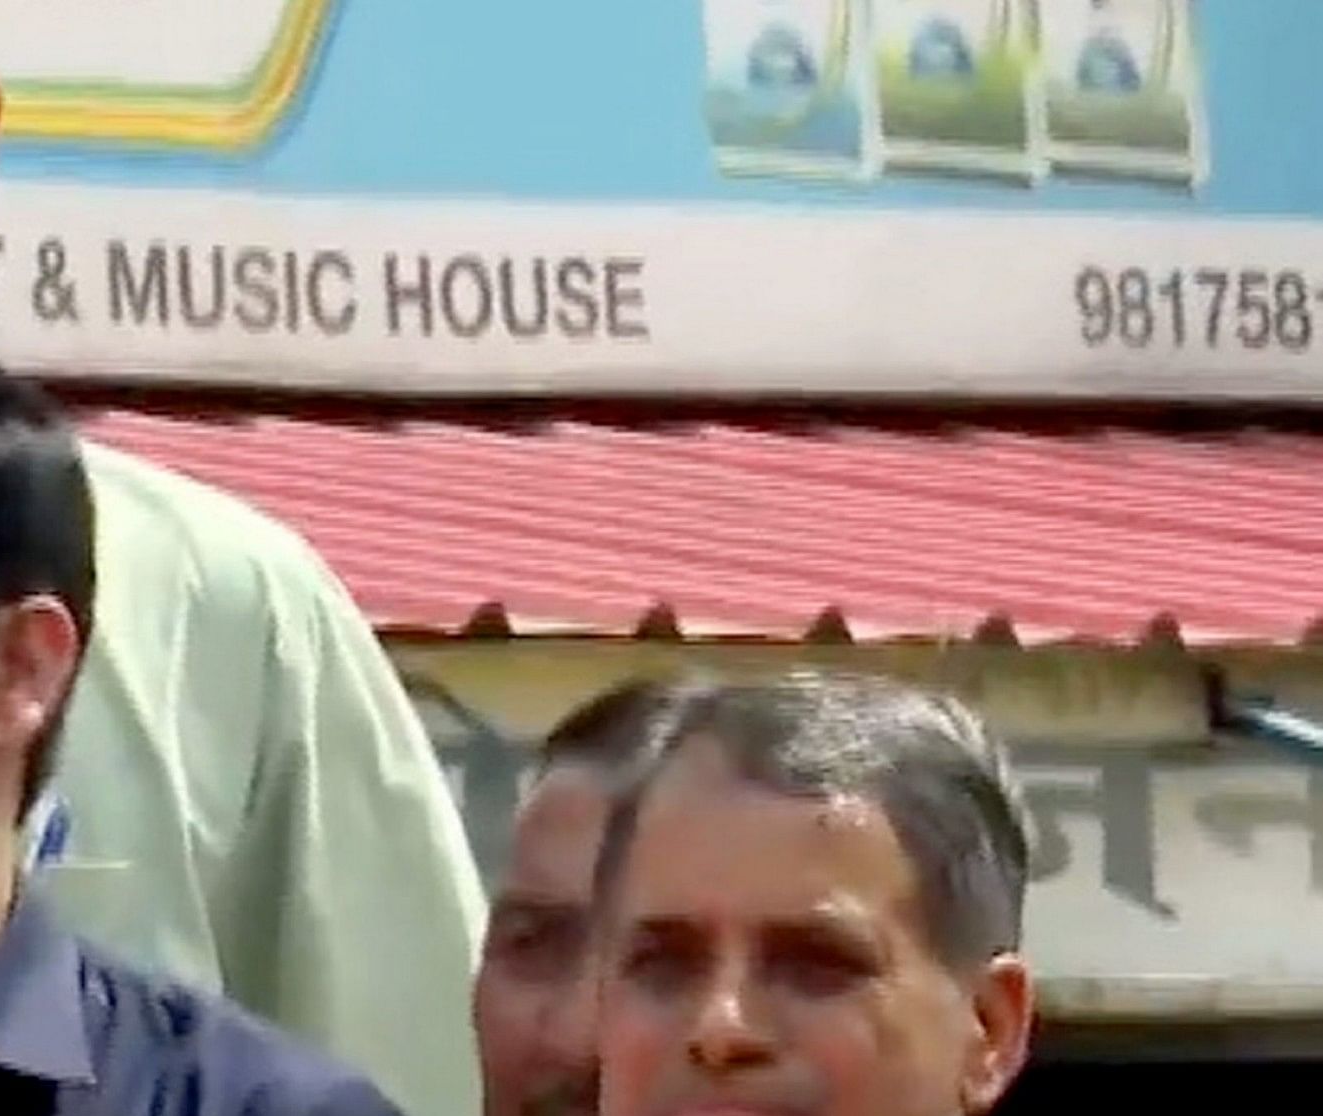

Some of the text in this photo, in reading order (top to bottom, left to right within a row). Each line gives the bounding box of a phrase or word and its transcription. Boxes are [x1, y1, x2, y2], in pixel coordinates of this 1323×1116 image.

[31, 238, 80, 322] &
[106, 238, 358, 336] MUSIC
[384, 250, 650, 342] HOUSE
[1074, 265, 1323, 352] 981758
